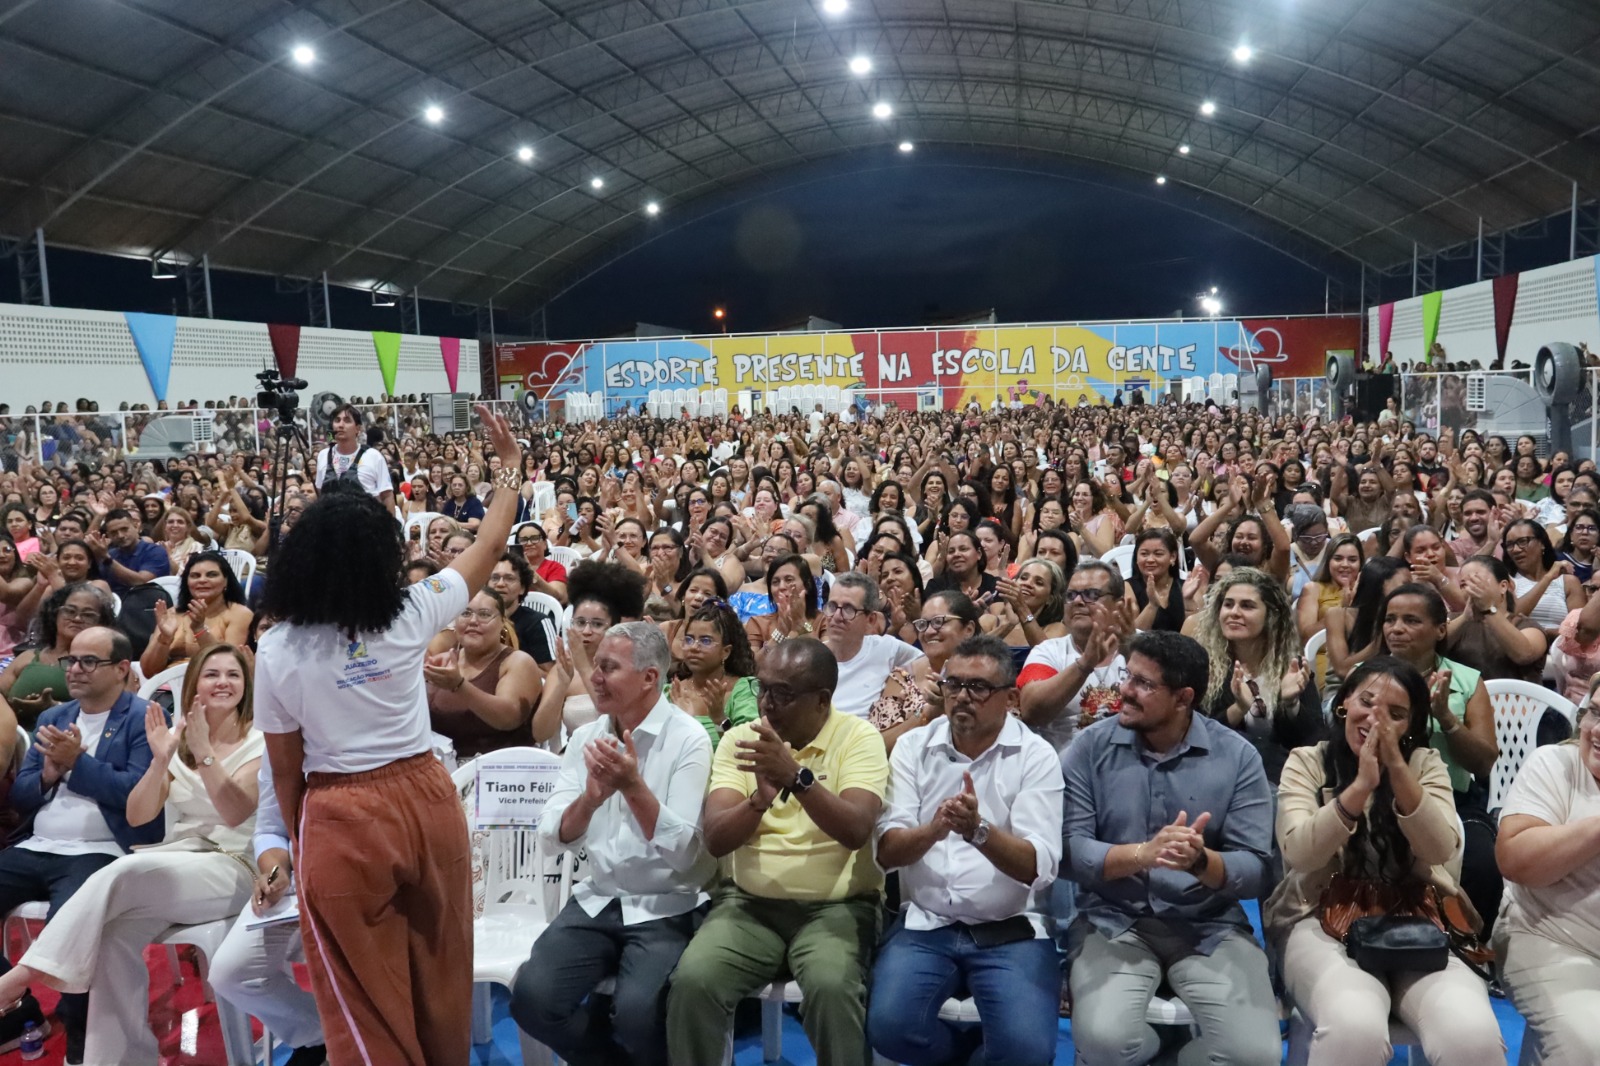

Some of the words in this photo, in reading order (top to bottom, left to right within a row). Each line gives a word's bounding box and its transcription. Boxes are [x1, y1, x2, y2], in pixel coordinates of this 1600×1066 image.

[606, 356, 719, 388] ESPORTE
[732, 352, 865, 383] PRESENTE
[878, 352, 912, 382] NA
[932, 345, 1036, 375] ESCOLA
[1050, 345, 1089, 373] DA
[1107, 343, 1196, 372] GENTE
[344, 659, 378, 671] JUAZEIRO
[485, 781, 526, 793] Tiano
[498, 797, 517, 805] Vice
